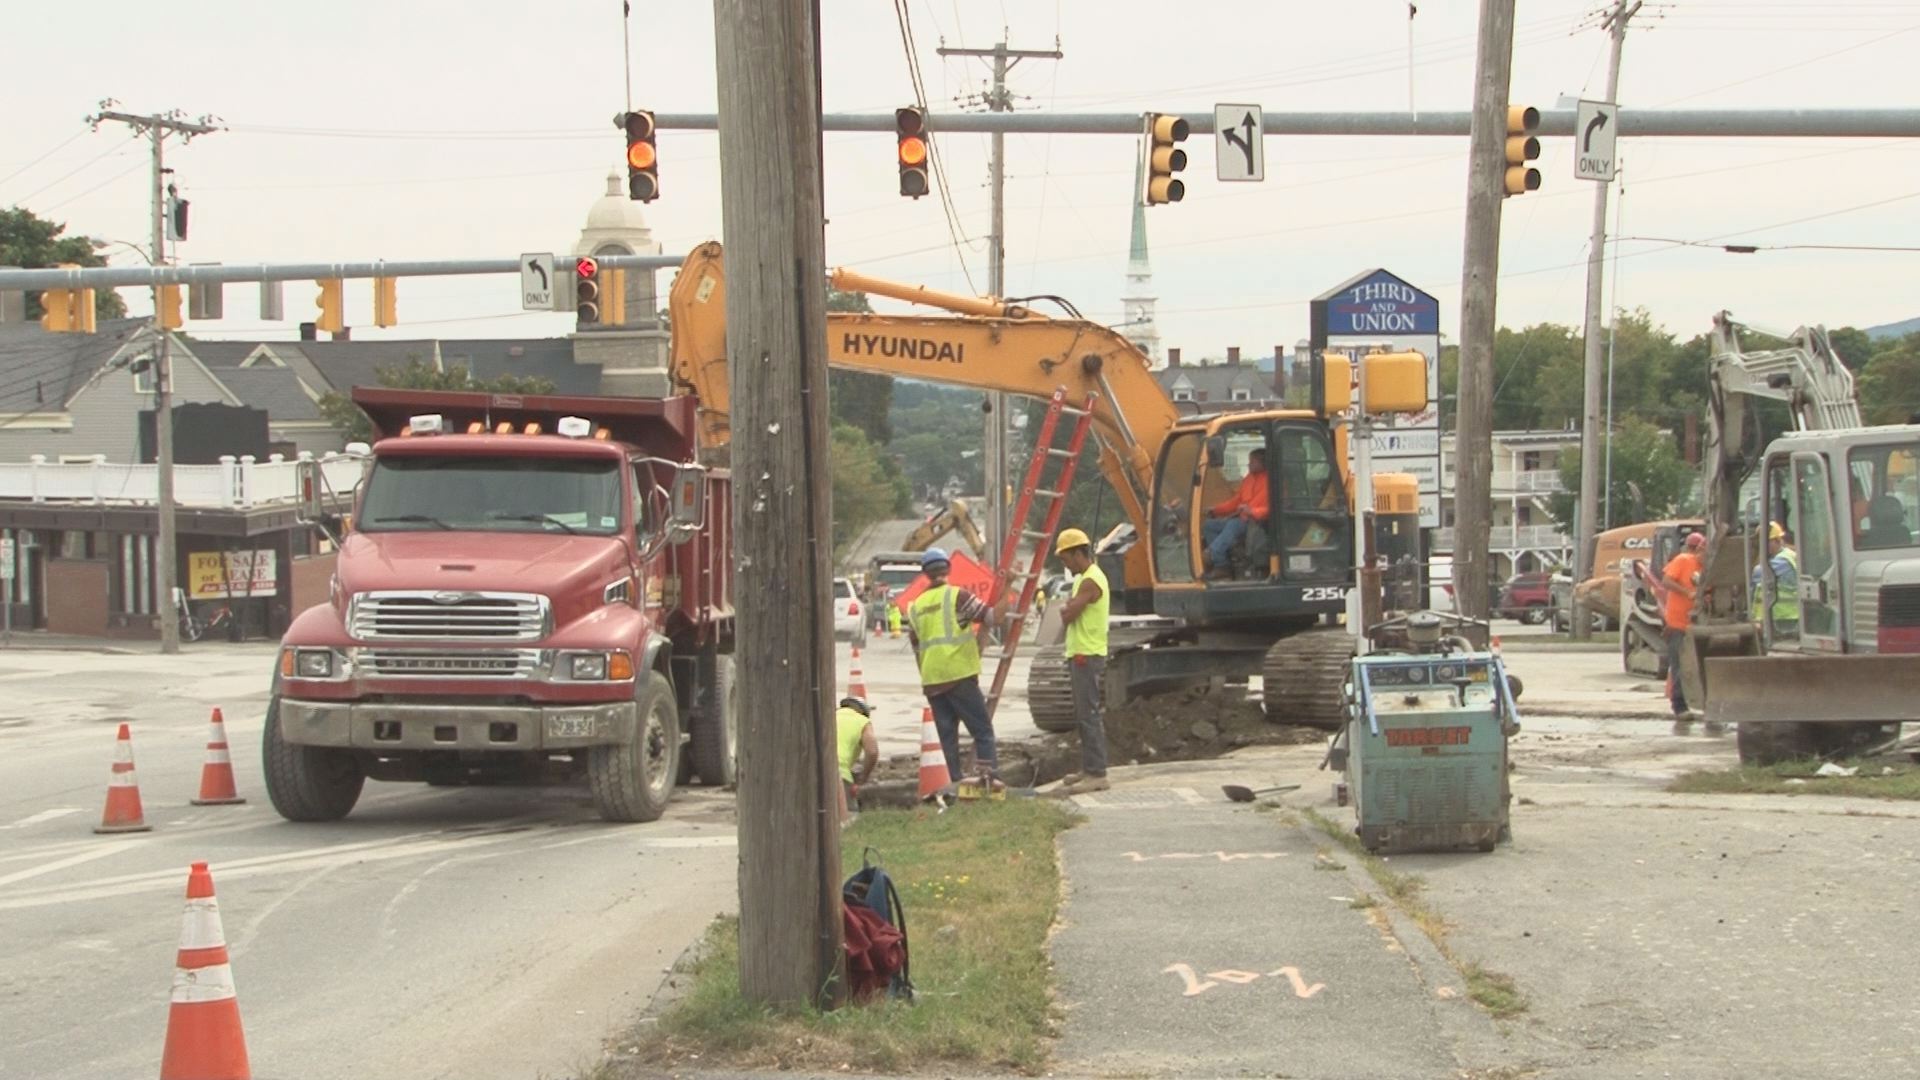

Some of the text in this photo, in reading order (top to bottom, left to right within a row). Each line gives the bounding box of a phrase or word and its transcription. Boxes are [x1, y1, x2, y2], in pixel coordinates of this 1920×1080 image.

[1580, 157, 1609, 174] ONLY
[526, 292, 550, 304] ONLY
[1350, 282, 1416, 304] THIRD
[1370, 302, 1396, 313] AND
[1351, 313, 1416, 331] UNION
[843, 333, 964, 363] HYUNDAI
[1624, 537, 1653, 549] CA
[232, 554, 268, 567] SAE
[386, 659, 507, 669] STERLING
